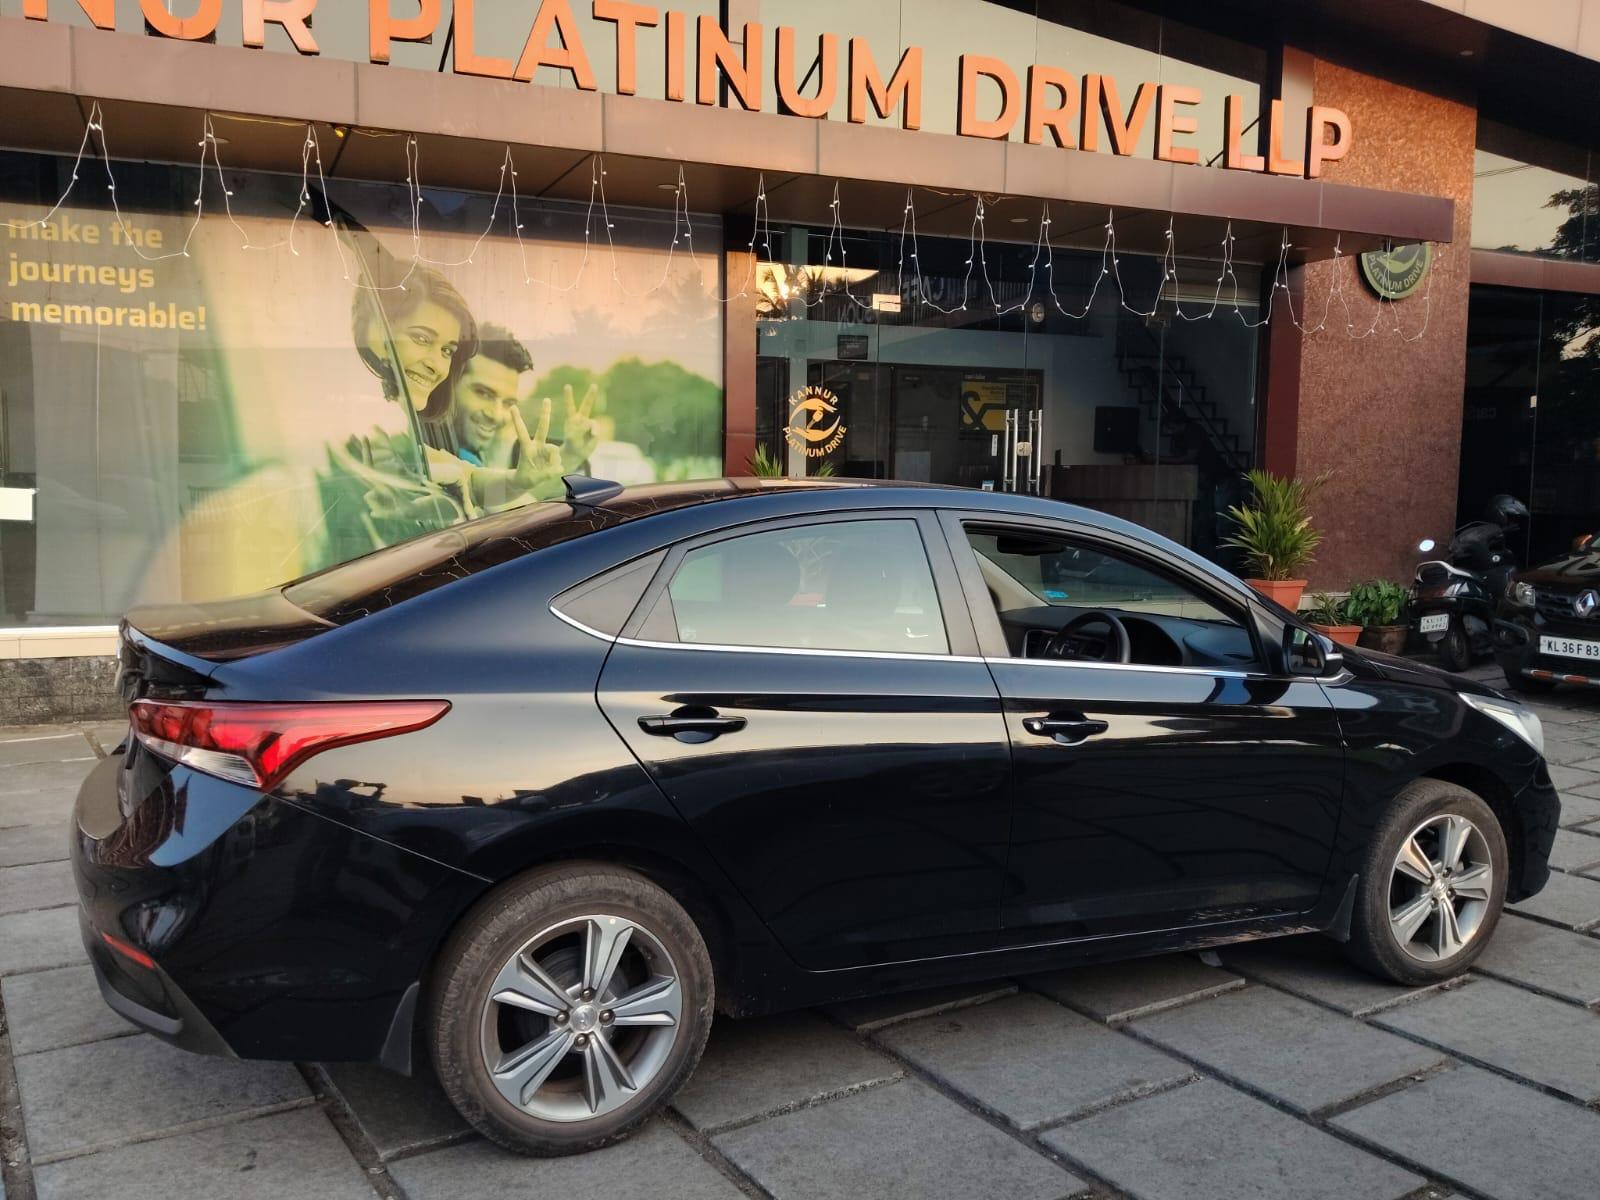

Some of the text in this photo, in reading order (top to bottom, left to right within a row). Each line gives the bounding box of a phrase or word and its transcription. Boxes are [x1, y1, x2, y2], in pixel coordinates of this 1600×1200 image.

[369, 0, 922, 131] PLATINUM
[957, 53, 1202, 167] DRIVE
[1223, 94, 1352, 180] LLP
[8, 215, 163, 249] make the
[8, 253, 155, 294] journeys
[1368, 254, 1424, 291] PLATINUM DRIVE
[11, 301, 207, 331] memorable!
[788, 386, 839, 406] KANNUR
[782, 425, 847, 458] PLATINUM DRIVE
